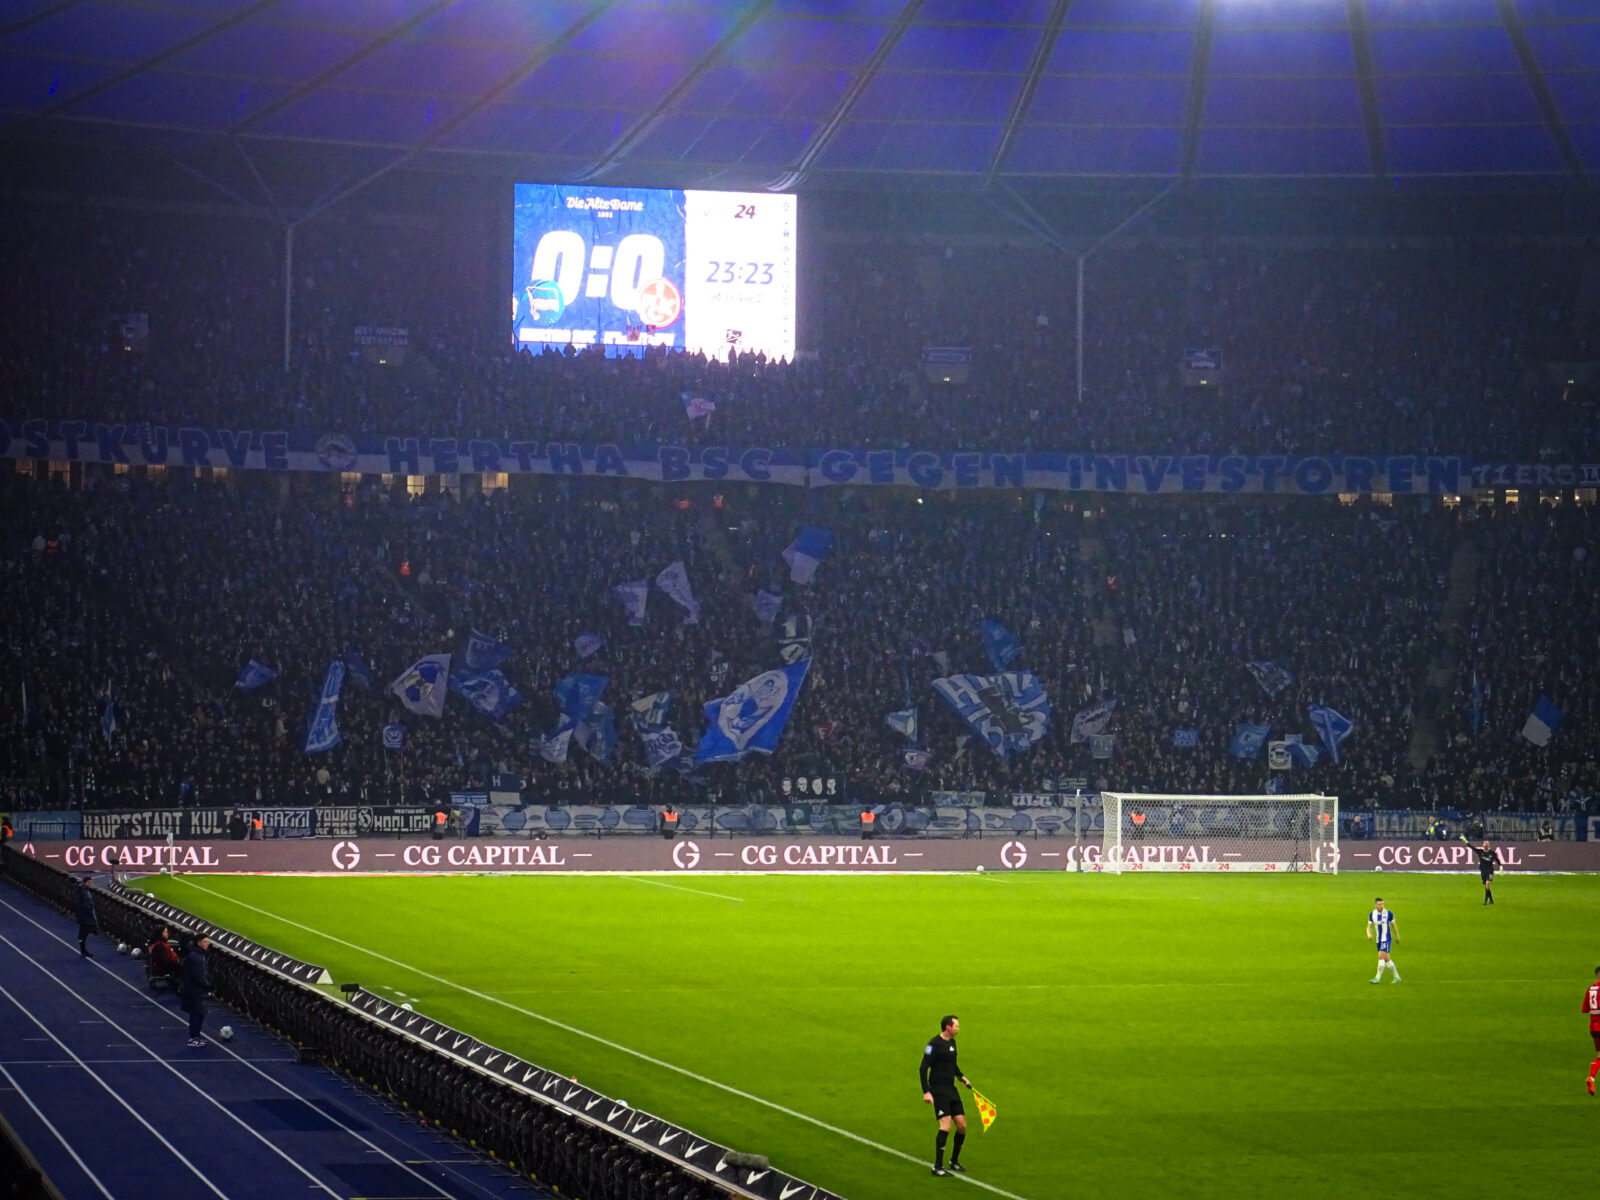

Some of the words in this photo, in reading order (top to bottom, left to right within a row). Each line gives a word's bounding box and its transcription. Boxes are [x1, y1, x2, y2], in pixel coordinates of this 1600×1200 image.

[566, 196, 584, 209] Die
[584, 196, 610, 210] Alte
[610, 198, 644, 211] Dame
[734, 204, 756, 219] 24
[705, 261, 775, 285] 23:23
[384, 437, 628, 478] HERTHA
[658, 446, 773, 482] BSC
[819, 449, 1026, 489] GEGEN
[1066, 454, 1462, 495] INVESTOREN
[83, 810, 183, 839] HAUPTSTADT
[315, 808, 357, 822] YOUNG
[65, 845, 96, 866] CG
[101, 845, 219, 866] CAPITAL
[403, 845, 441, 866] CG
[447, 845, 565, 866] CAPITAL
[741, 845, 778, 865] CG
[783, 845, 897, 865] CAPITAL
[1067, 845, 1101, 863] CG
[1108, 845, 1216, 864] CAPITAL
[1378, 845, 1412, 865] CG
